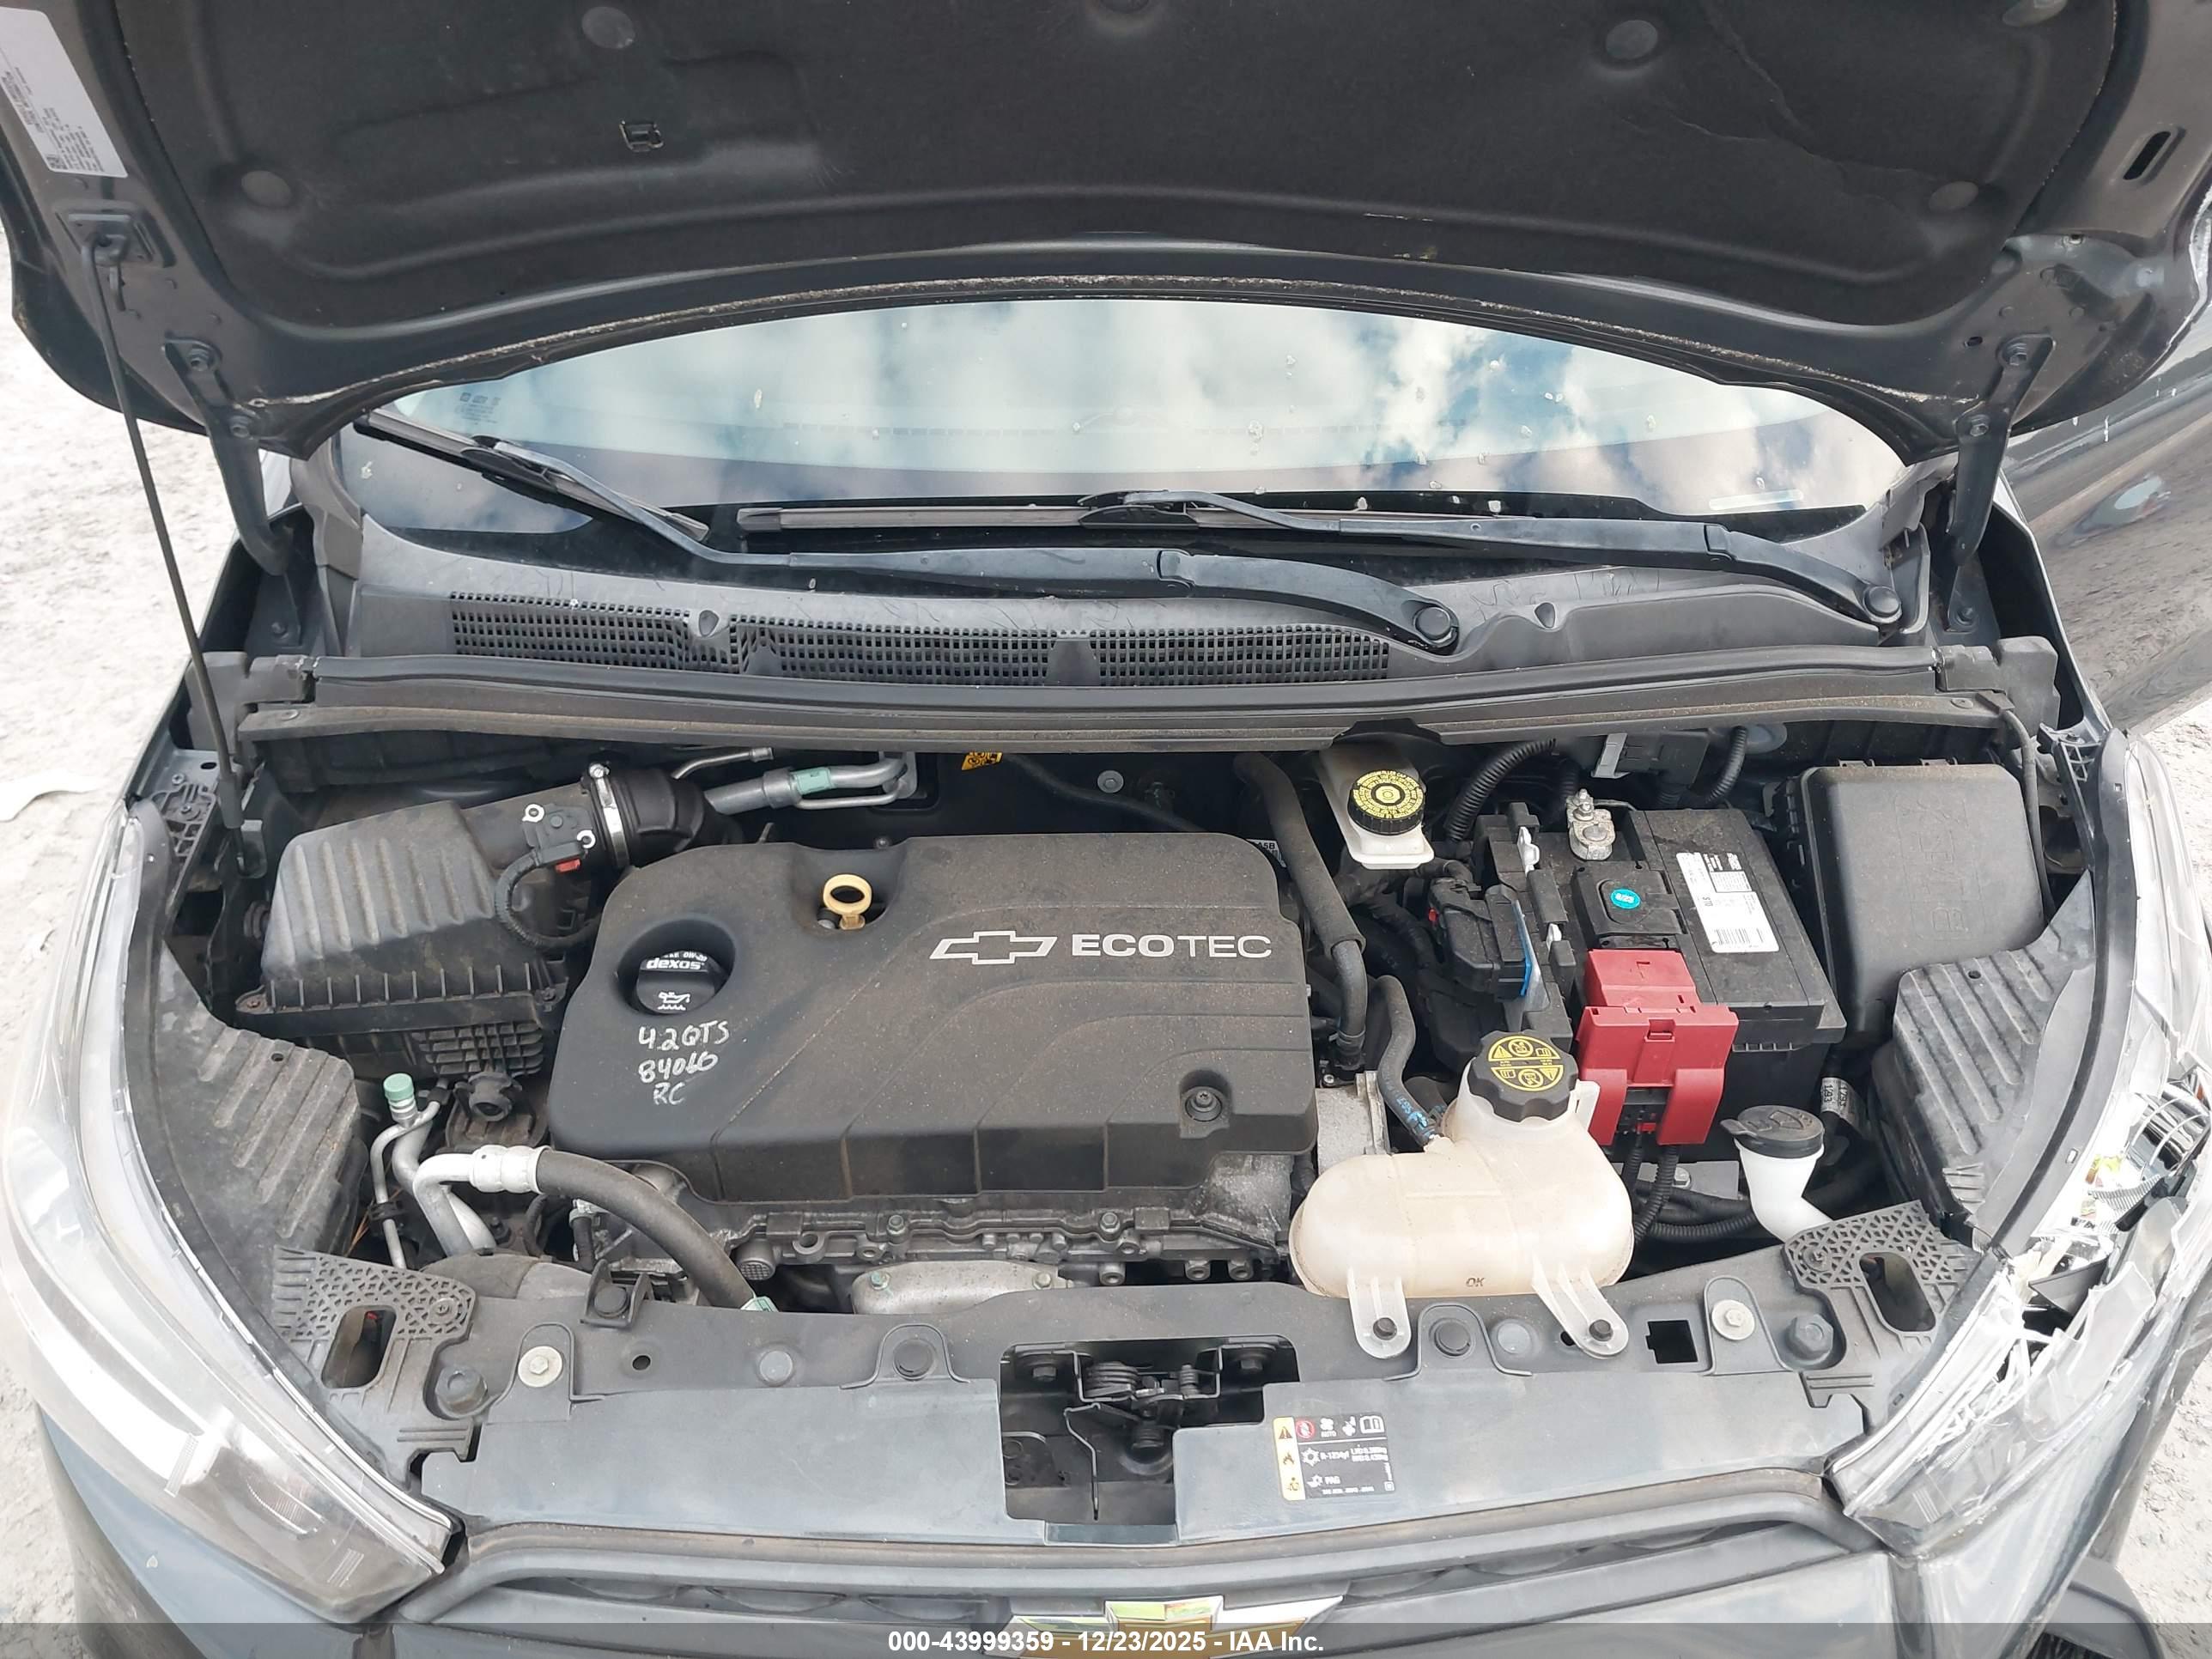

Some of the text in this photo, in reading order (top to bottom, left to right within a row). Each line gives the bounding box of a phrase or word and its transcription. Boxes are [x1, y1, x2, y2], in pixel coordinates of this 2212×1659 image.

[1072, 933, 1272, 958] ECOTEC
[646, 957, 702, 969] dexos
[653, 1081, 686, 1105] RC
[1466, 1277, 1486, 1288] OK
